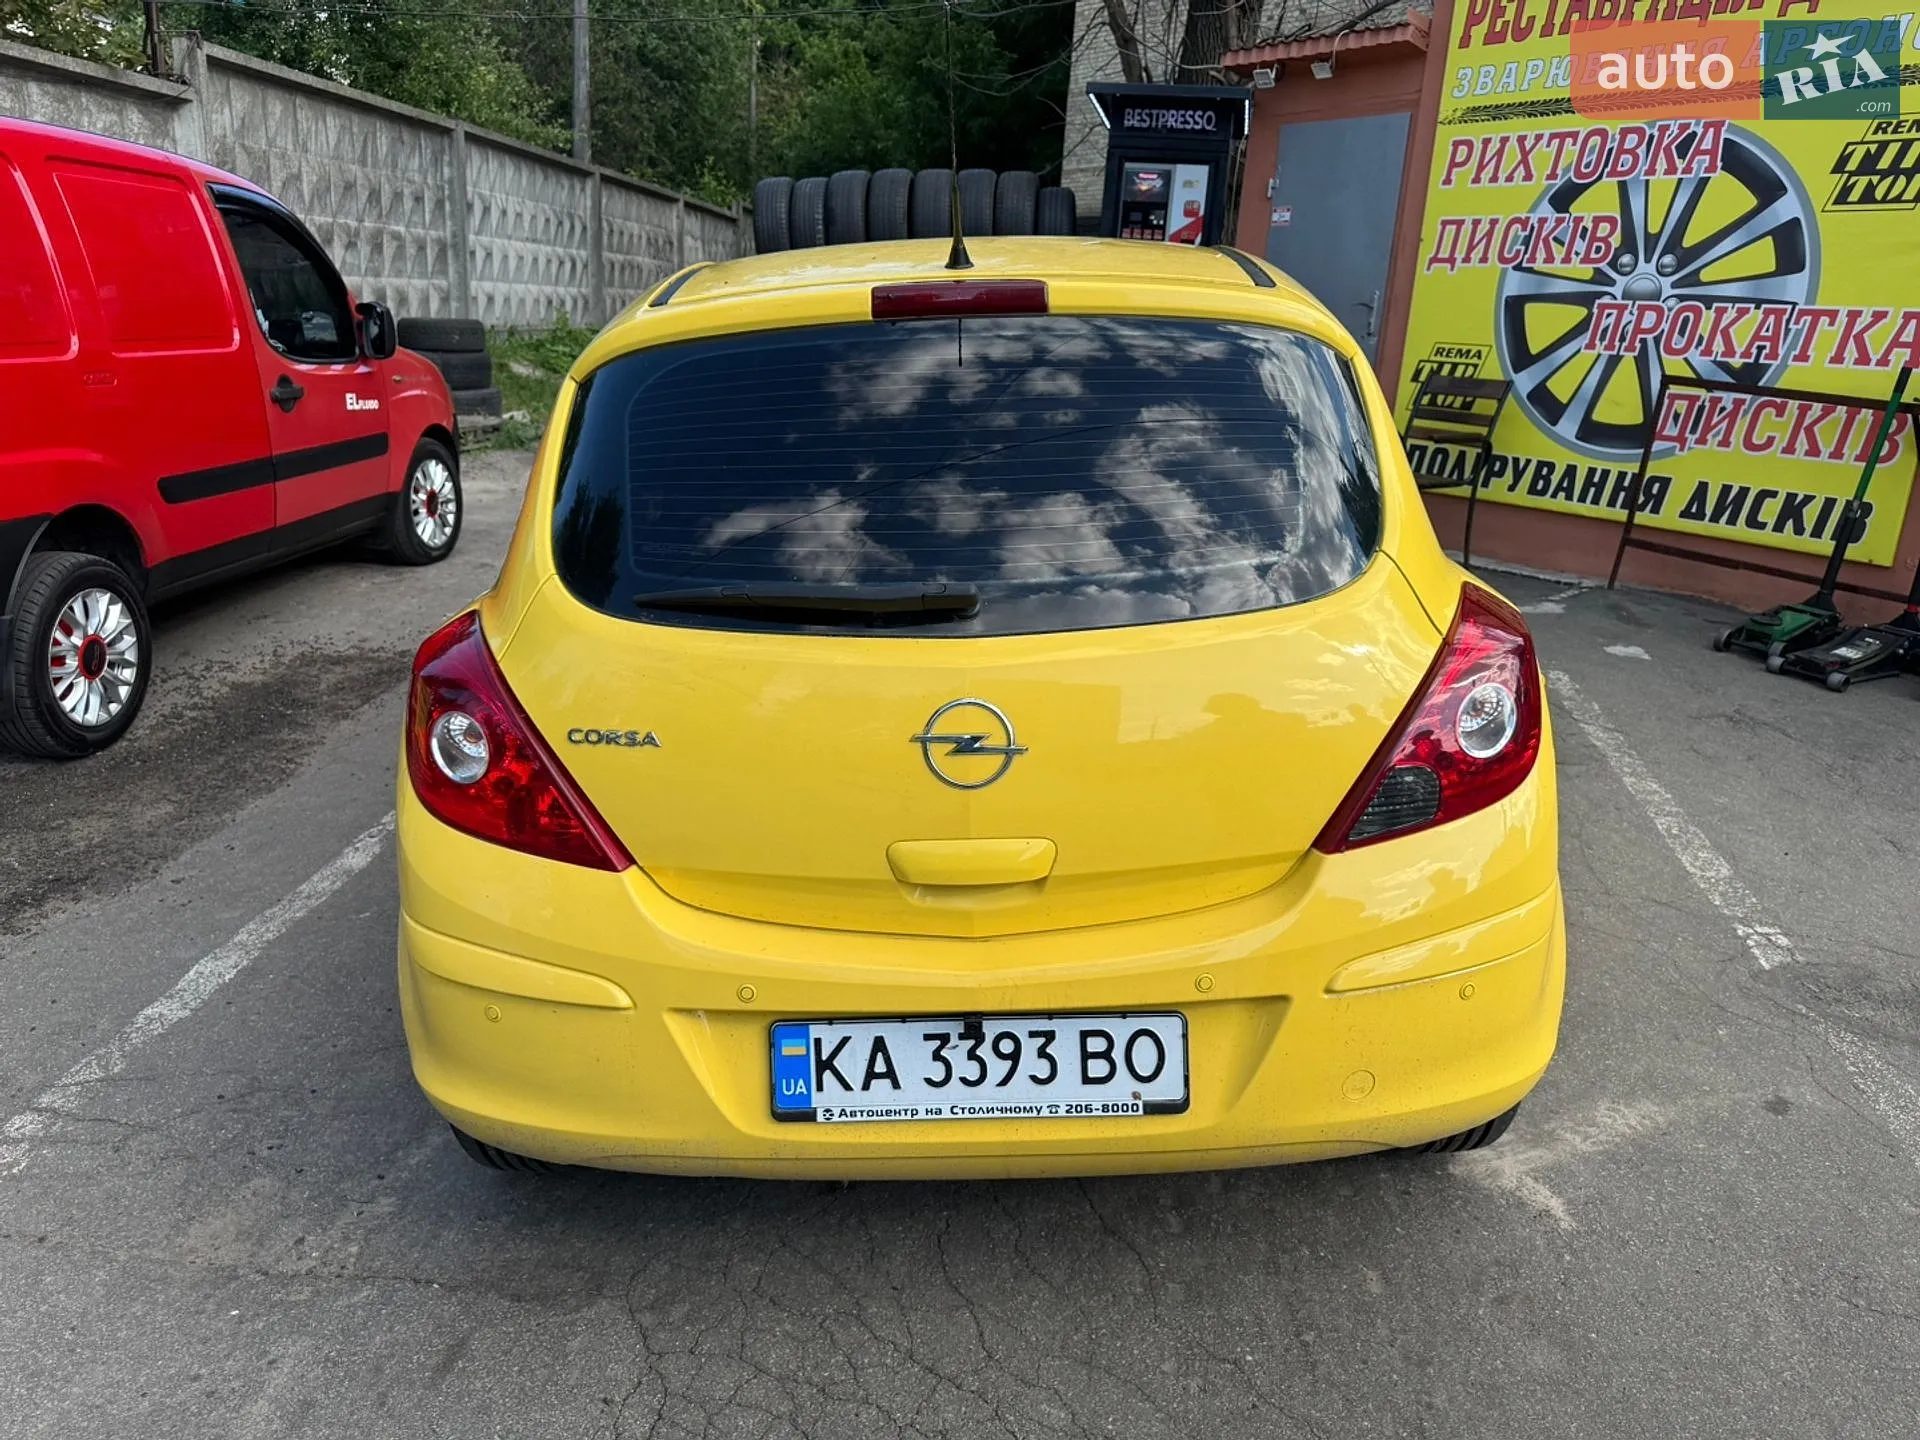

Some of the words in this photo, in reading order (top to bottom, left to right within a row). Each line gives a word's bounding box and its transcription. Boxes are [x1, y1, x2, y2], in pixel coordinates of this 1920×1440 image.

[1739, 11, 1920, 69] АРГОН
[1441, 119, 1727, 188] РИХТОВКА
[1426, 215, 1620, 272] ДИСКІВ
[1434, 346, 1483, 361] REMA
[1584, 301, 1920, 369] ПРОКАТКА
[1654, 392, 1909, 466] ДИСКІВ
[1679, 479, 1874, 544] ДИСКІВ
[567, 728, 662, 748] CORSA
[782, 1078, 807, 1095] UA
[923, 1029, 1058, 1087] 3393
[838, 1107, 919, 1119] Автоцентр
[925, 1106, 943, 1116] на
[950, 1103, 1043, 1116] Столичному
[1065, 1102, 1140, 1115] 206-8000
